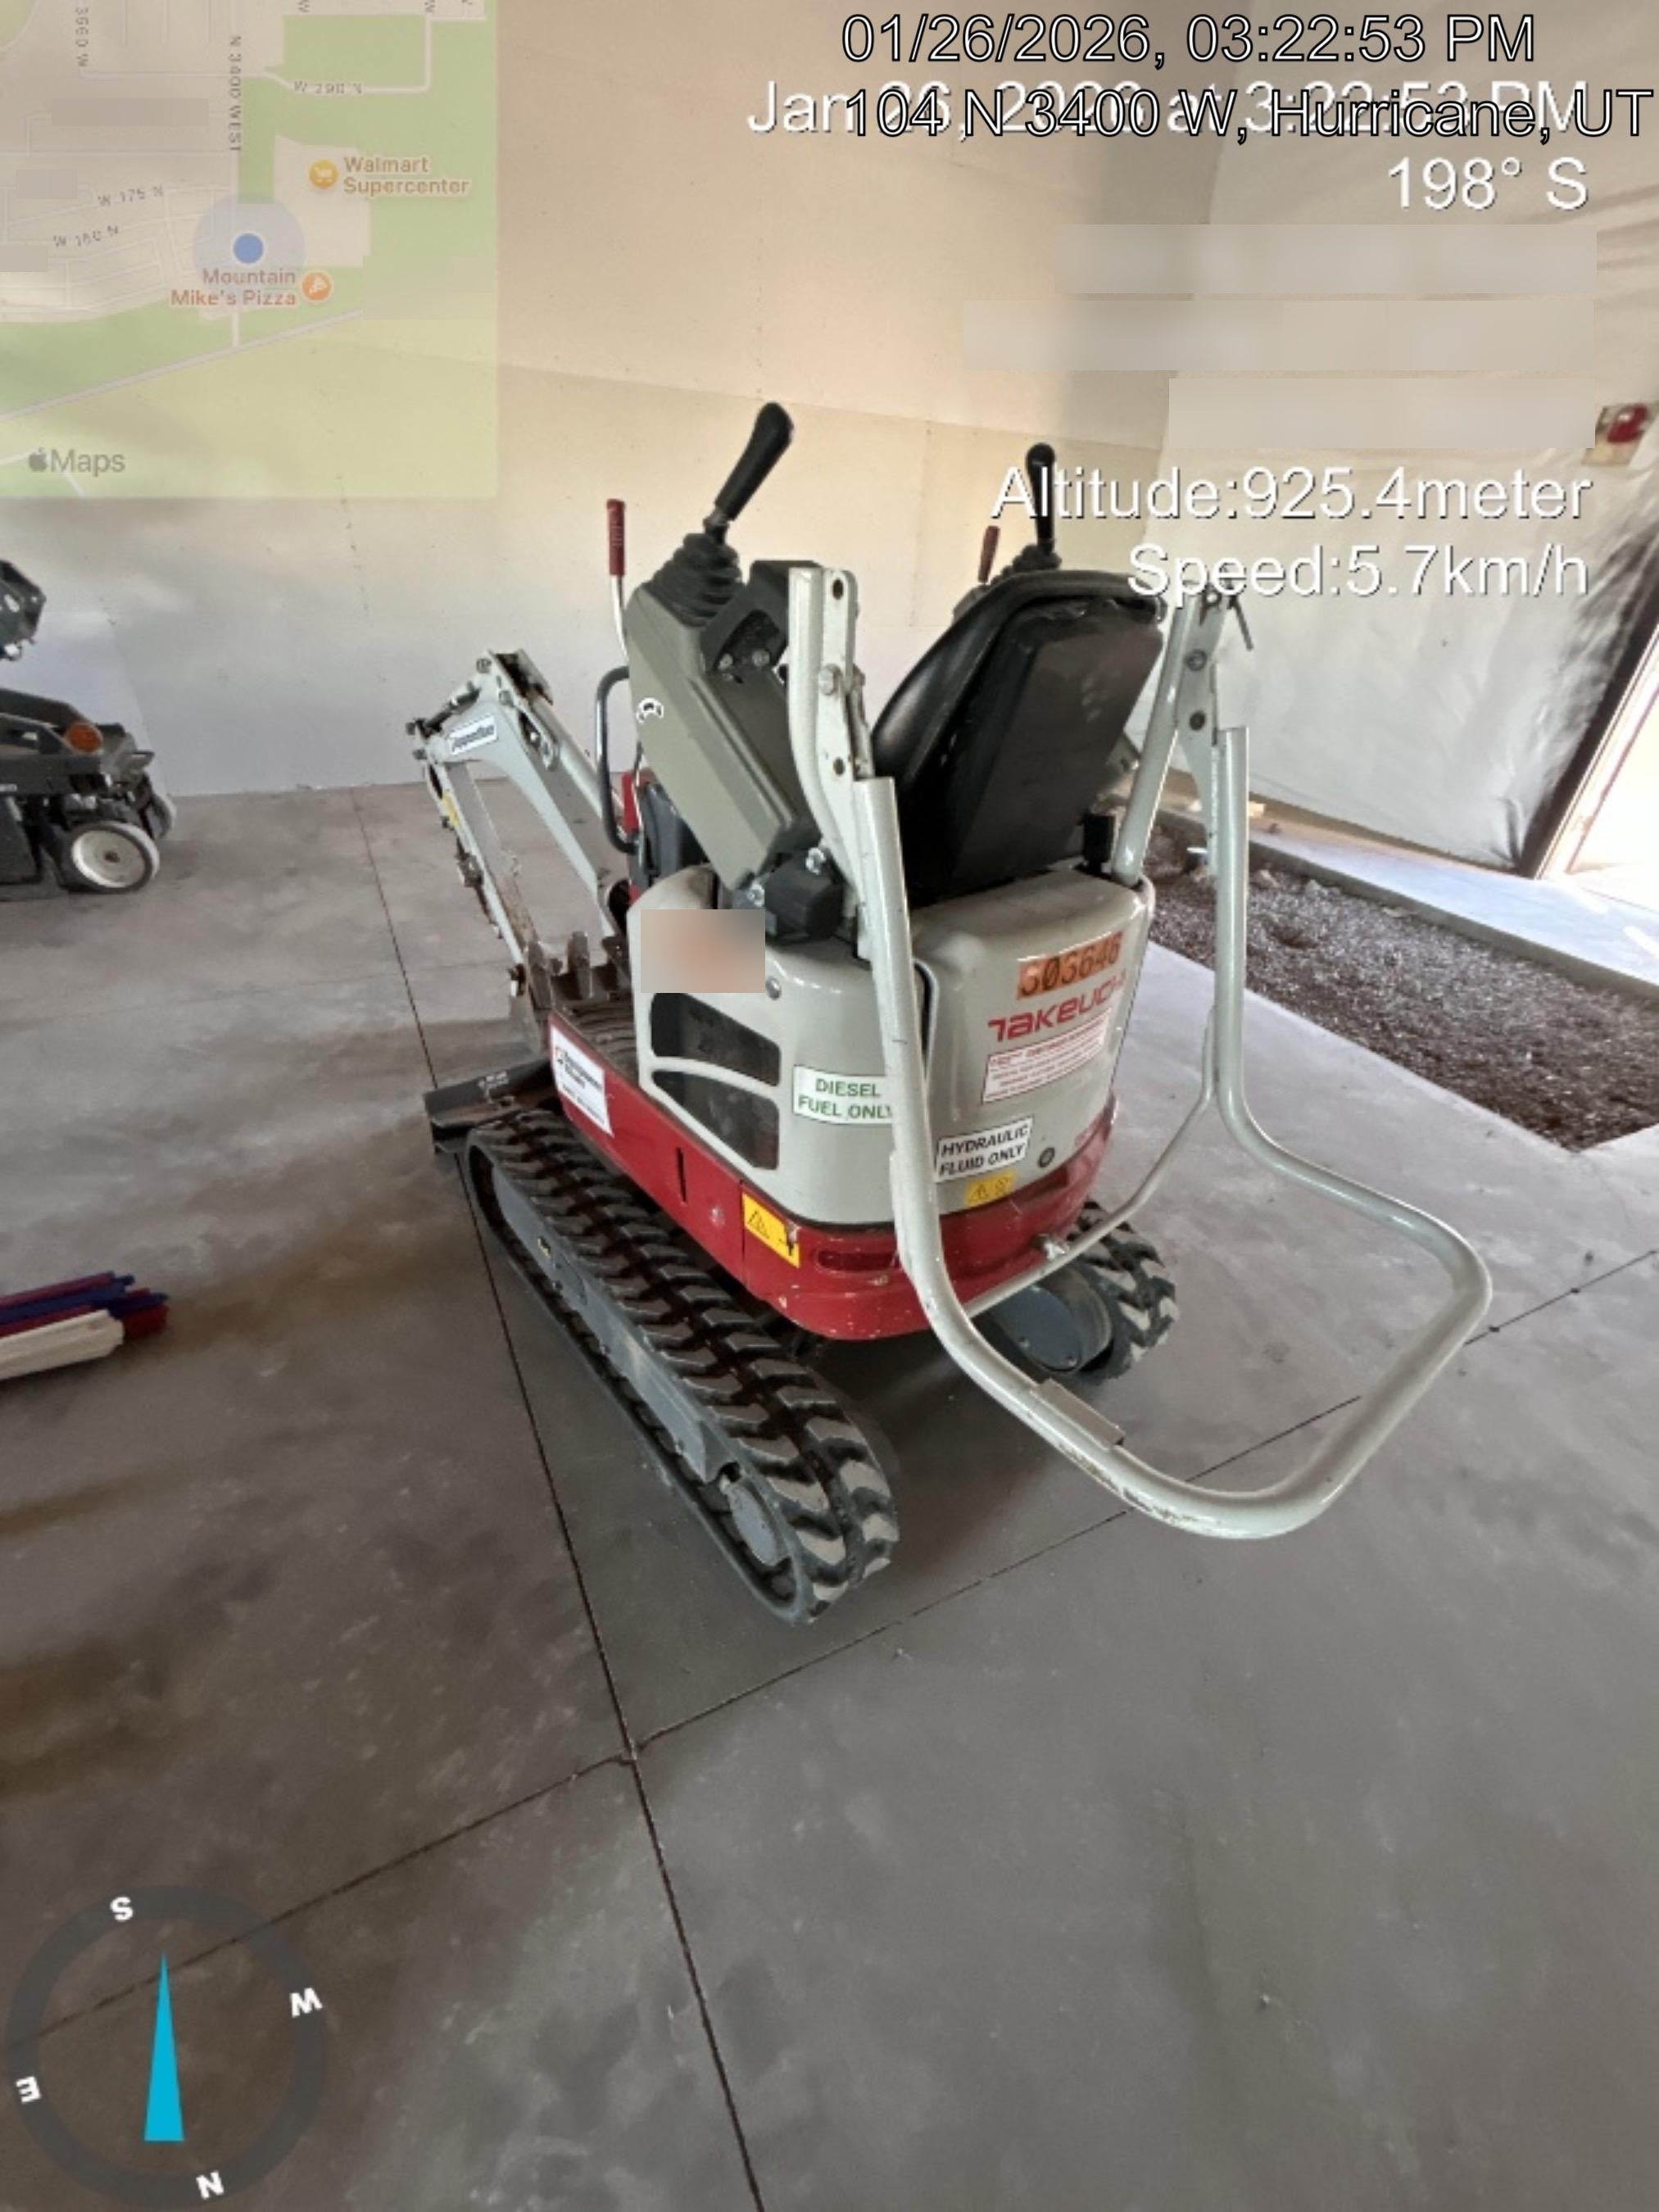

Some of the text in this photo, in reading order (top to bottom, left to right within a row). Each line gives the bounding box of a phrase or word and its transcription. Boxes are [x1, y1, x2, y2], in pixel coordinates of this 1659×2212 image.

[815, 1078, 881, 1098] DIESEL
[798, 1095, 841, 1117] FUEL
[942, 1124, 1030, 1158] HYDRAULIC
[939, 1144, 1024, 1176] FLUID ONLY
